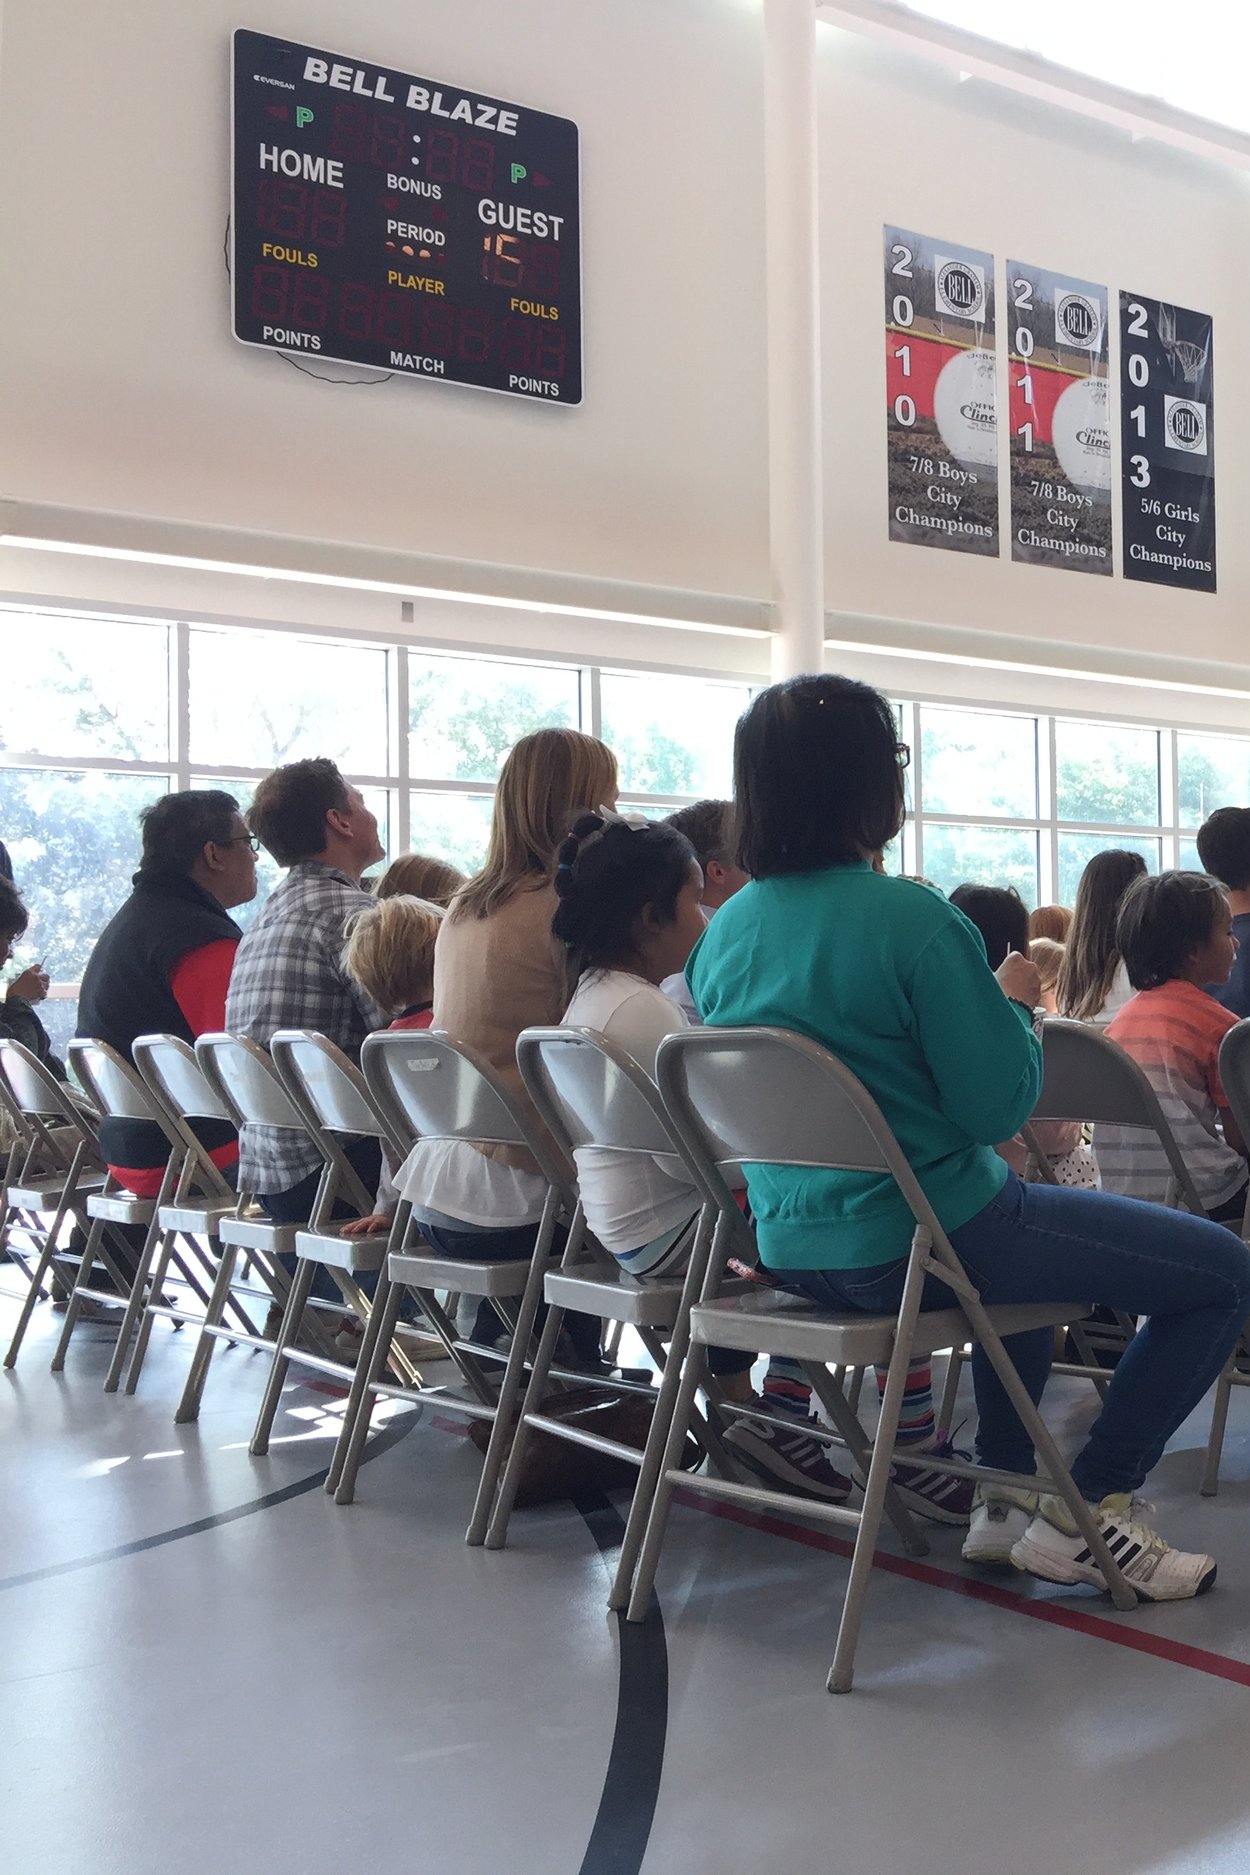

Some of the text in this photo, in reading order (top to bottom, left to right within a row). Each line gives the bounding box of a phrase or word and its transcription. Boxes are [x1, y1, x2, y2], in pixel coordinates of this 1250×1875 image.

[260, 76, 295, 91] EVERSAN
[303, 56, 519, 136] BELL BLAZE
[296, 105, 314, 128] P
[260, 142, 344, 188] HOME
[511, 162, 527, 184] P
[387, 173, 442, 200] BONUS
[387, 219, 445, 246] PERIOD
[478, 198, 564, 241] GUEST
[262, 242, 319, 267] FOULS
[388, 270, 445, 296] PLAYER
[948, 273, 974, 304] BELL
[510, 297, 559, 320] FOULS
[1067, 305, 1090, 335] BELL
[263, 325, 321, 350] POINTS
[390, 350, 445, 374] MATCH
[509, 374, 559, 396] POINTS
[1175, 411, 1198, 439] BELL
[910, 455, 978, 486] 7/8 Boys
[927, 485, 962, 511] City
[1031, 480, 1093, 509] 7/8 Boys
[895, 505, 993, 537] Champions
[1047, 508, 1079, 533] City
[1140, 497, 1200, 523] 5/6 Girls
[1018, 528, 1106, 558] Champions
[1156, 524, 1186, 548] City
[1129, 543, 1212, 572] Champions
